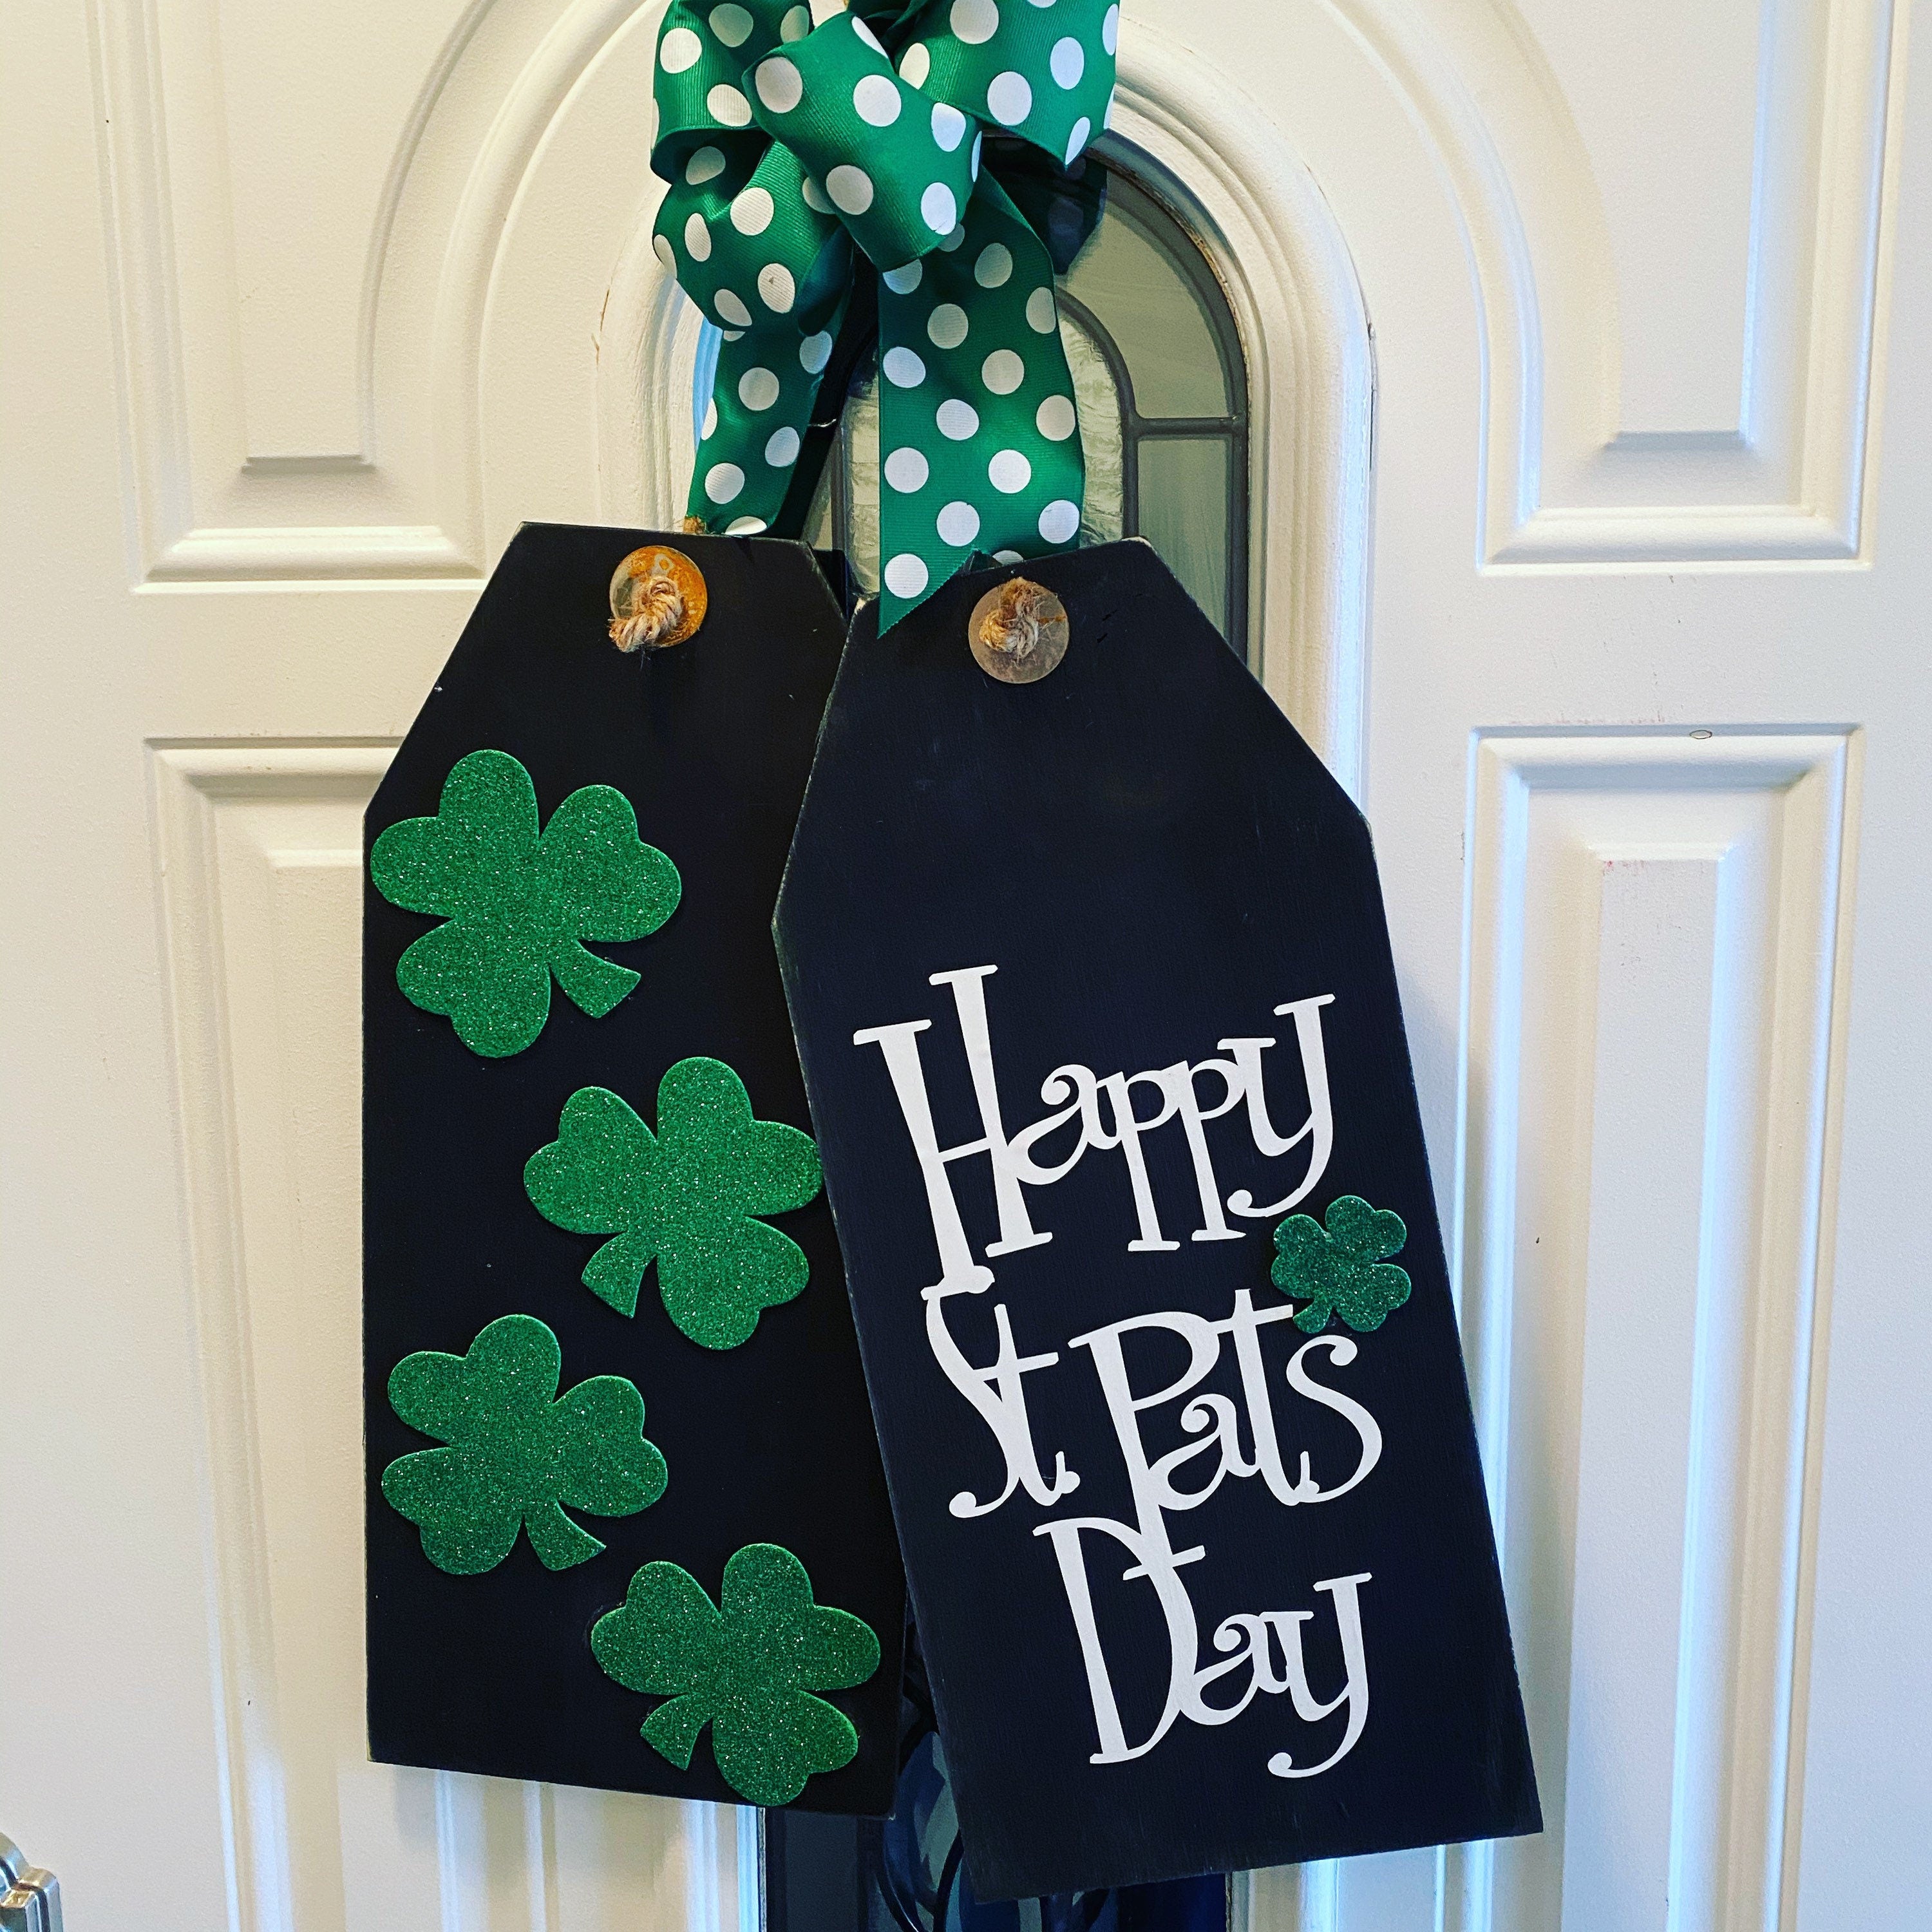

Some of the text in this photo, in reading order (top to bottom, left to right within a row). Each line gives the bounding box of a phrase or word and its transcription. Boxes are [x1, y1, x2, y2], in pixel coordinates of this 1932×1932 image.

[853, 965, 1335, 1299] Happy
[1068, 1289, 1382, 1580] Pats
[1032, 1517, 1372, 1778] Day
